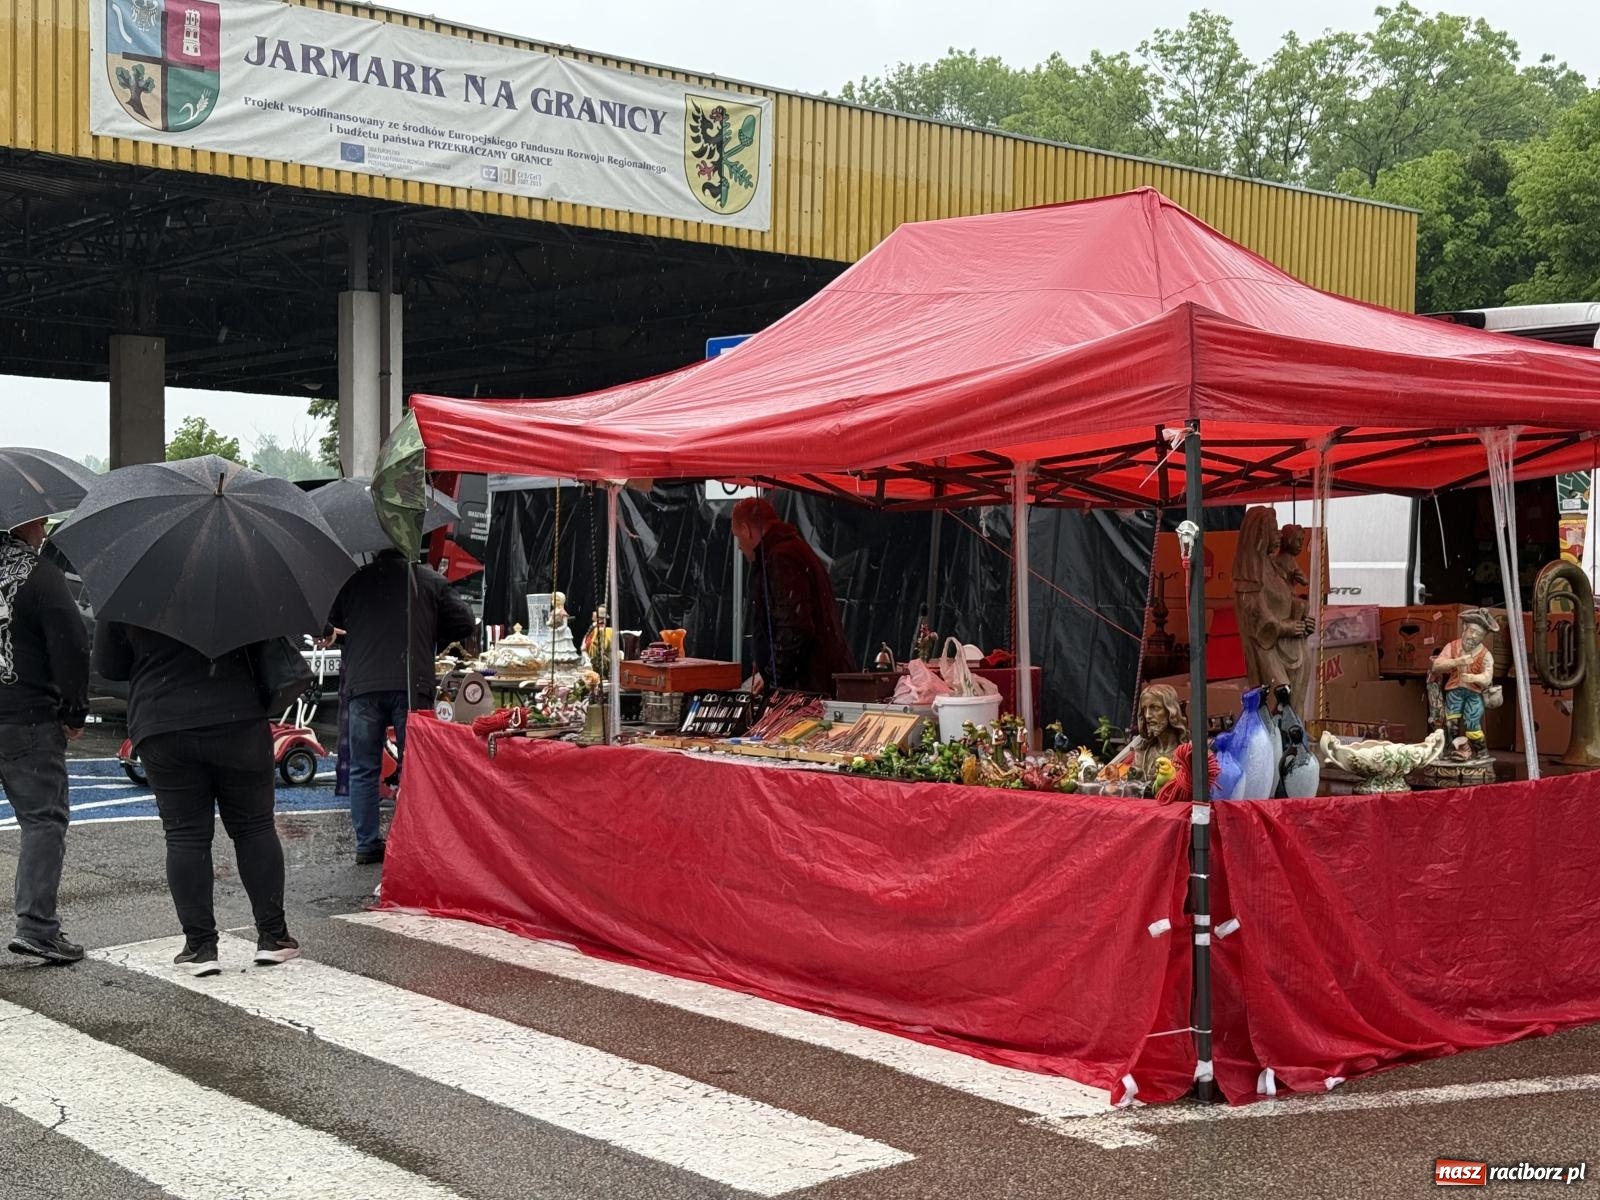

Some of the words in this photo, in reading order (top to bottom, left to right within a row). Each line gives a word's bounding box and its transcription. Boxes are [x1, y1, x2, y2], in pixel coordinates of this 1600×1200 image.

[243, 35, 446, 97] JARMARK
[464, 73, 518, 110] NA
[530, 87, 668, 135] GRANICY
[243, 96, 285, 111] Projekt
[288, 104, 385, 129] współfinansowany
[388, 121, 400, 130] ze
[402, 121, 446, 137] środków
[449, 130, 518, 150] Europejskiego
[521, 141, 565, 156] Funduszu
[567, 149, 605, 164] Rozwoju
[607, 155, 667, 174] Regionalnego
[329, 123, 333, 133] i
[336, 125, 379, 140] budżetu
[382, 134, 425, 147] państwa
[428, 140, 508, 160] PRZEKRACZAMY
[510, 152, 553, 167] GRANICE
[482, 167, 497, 179] CZ
